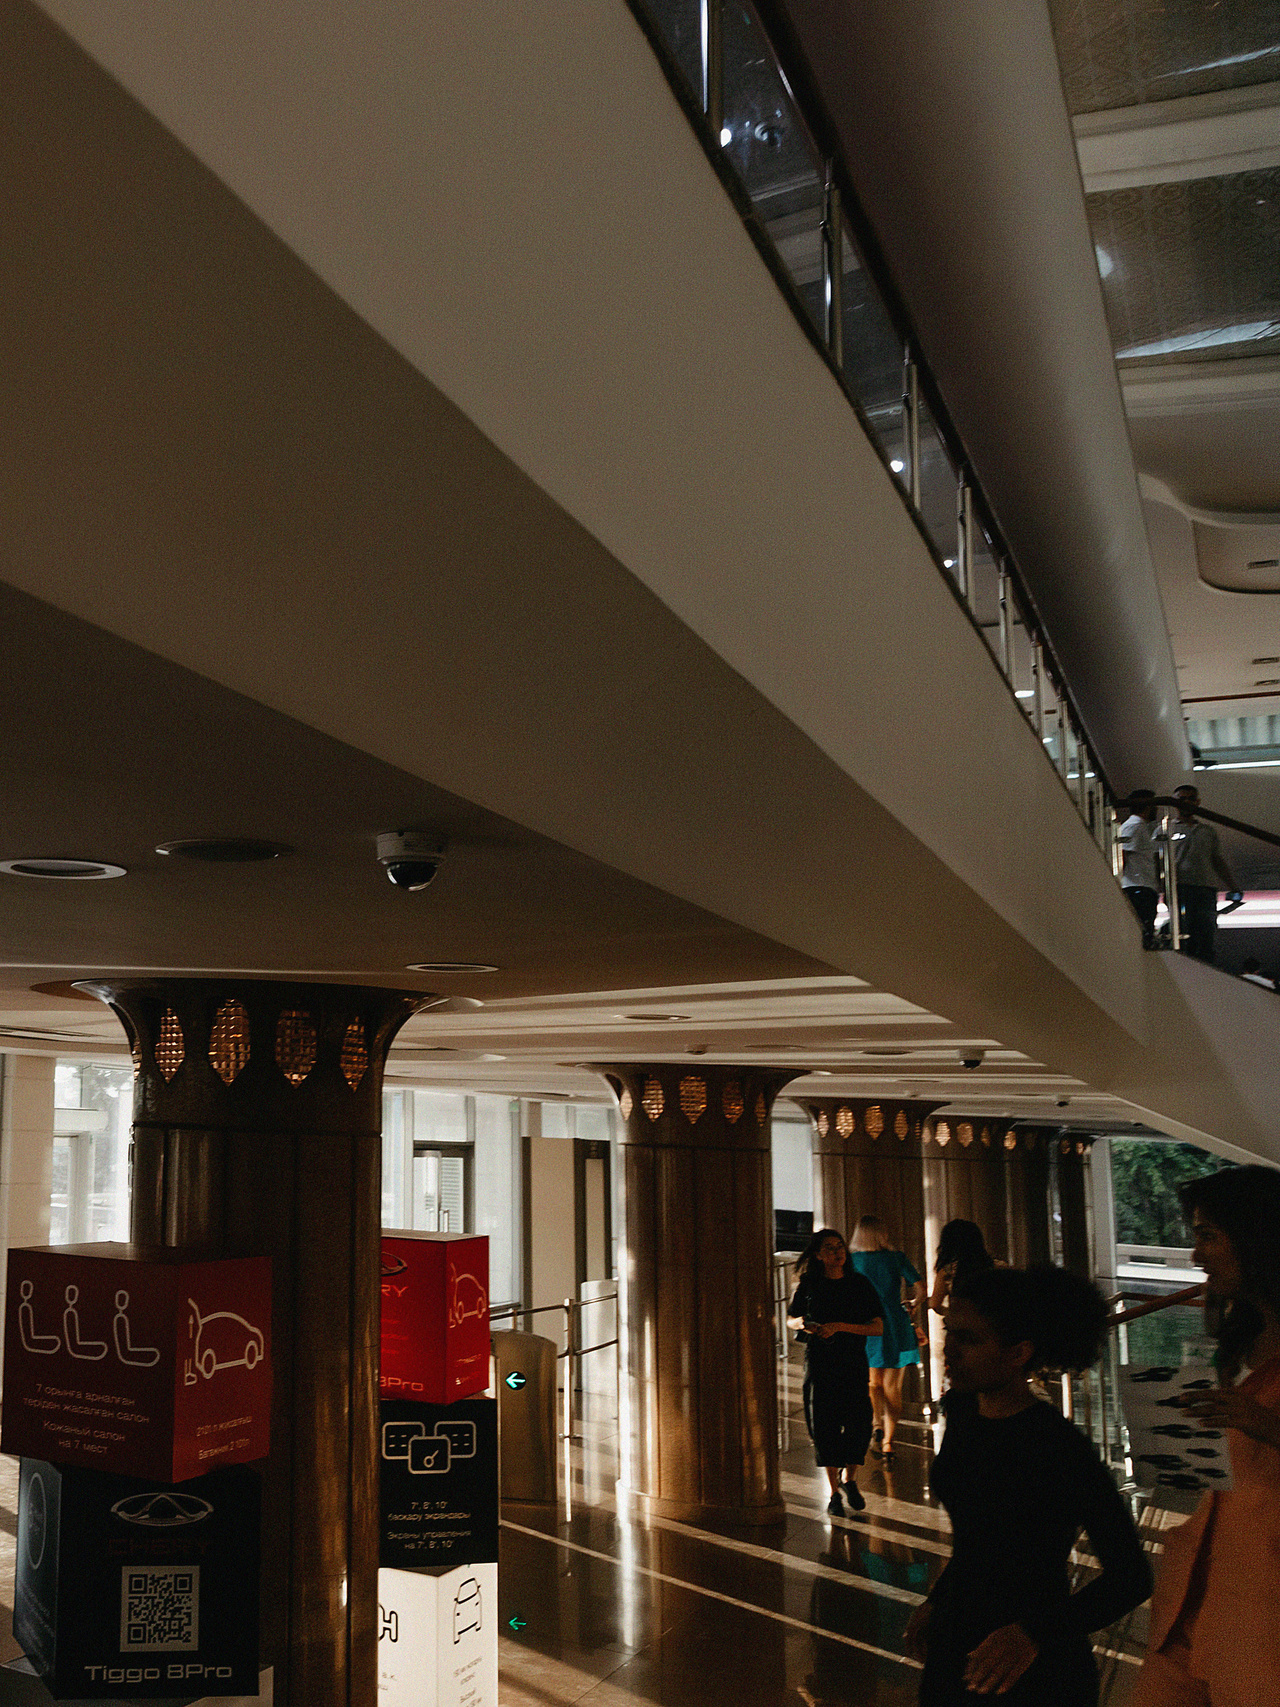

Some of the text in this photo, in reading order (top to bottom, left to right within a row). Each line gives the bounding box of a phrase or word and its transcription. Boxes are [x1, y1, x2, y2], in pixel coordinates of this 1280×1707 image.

[35, 1383, 135, 1406] 7 орынға арналған
[63, 1403, 115, 1418] жасалған
[116, 1411, 150, 1424] салон
[43, 1419, 126, 1442] Кожаный салон
[58, 1439, 108, 1455] на 7 мест
[84, 1663, 233, 1684] Tiggo 8Pro
